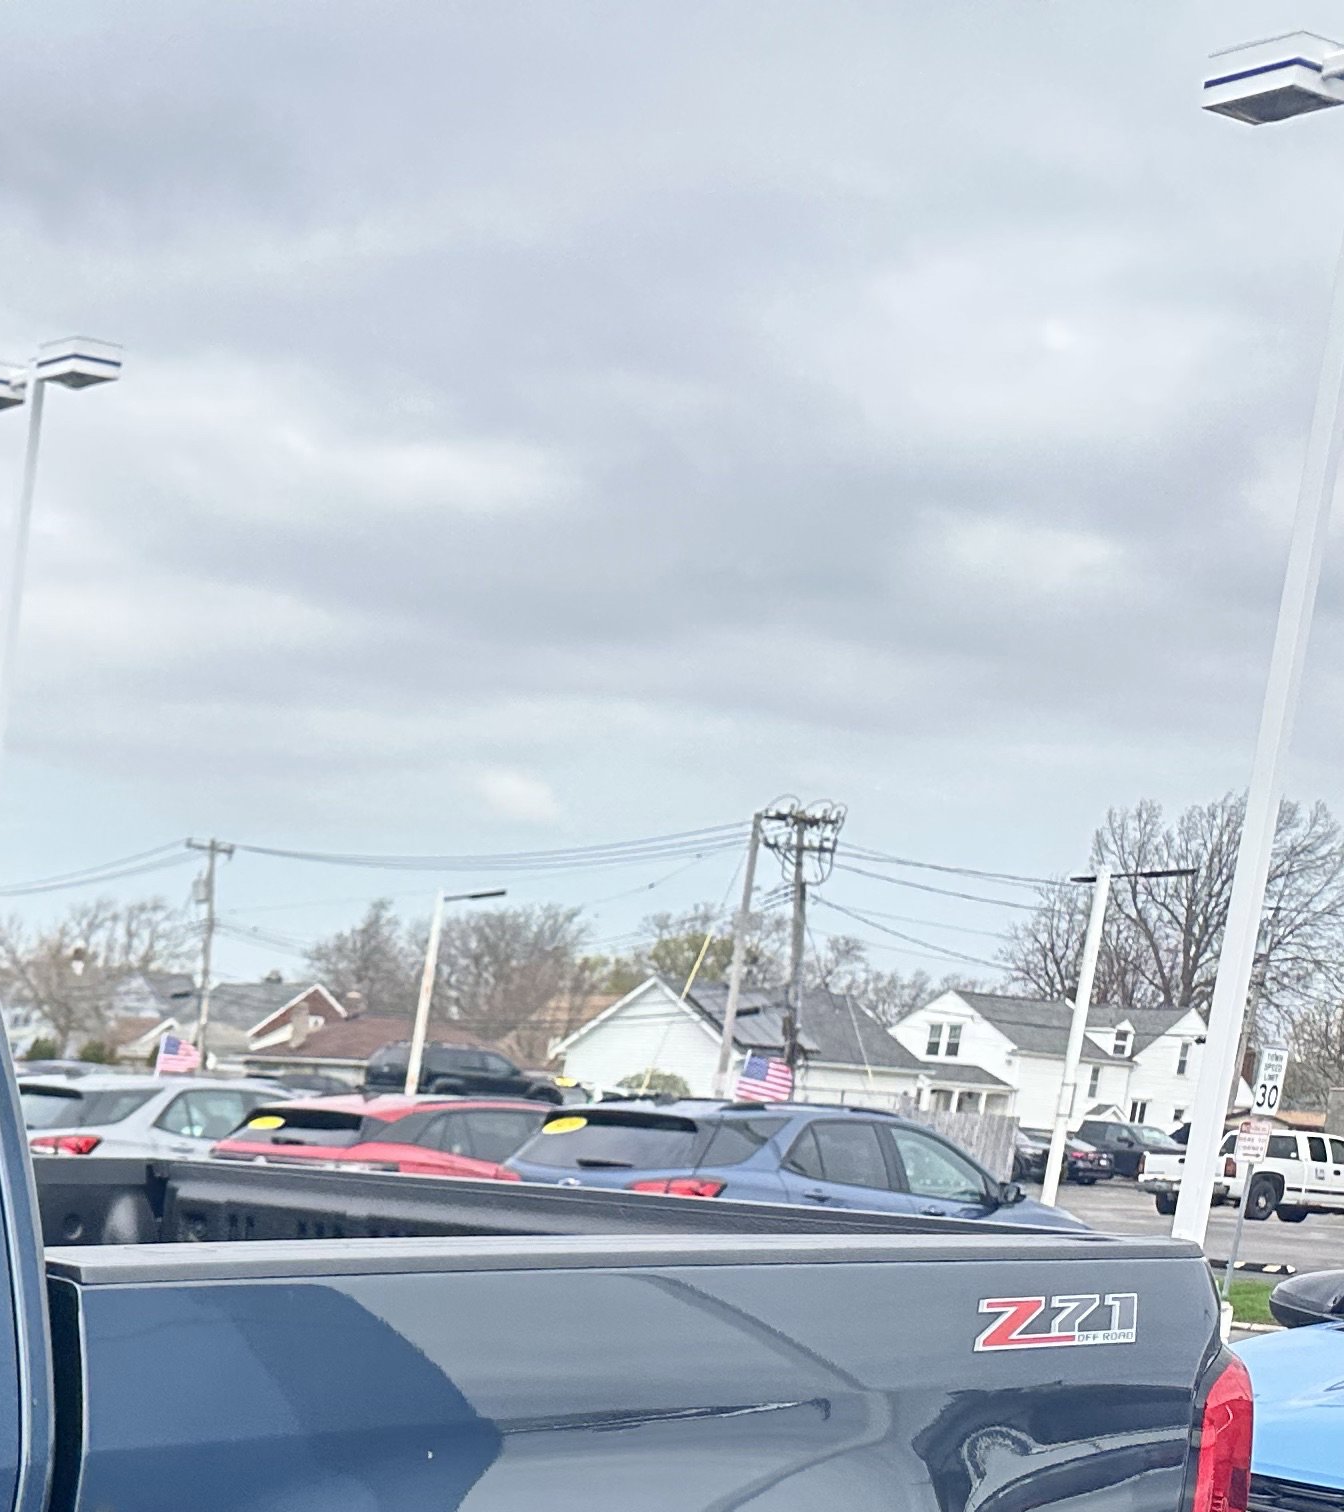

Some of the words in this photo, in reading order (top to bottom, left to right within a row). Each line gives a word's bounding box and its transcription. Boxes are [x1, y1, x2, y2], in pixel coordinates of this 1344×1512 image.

[1264, 1063, 1282, 1073] SPEED
[1256, 1084, 1278, 1109] 30
[973, 1293, 1138, 1352] Z71
[1078, 1334, 1099, 1342] OFF
[1103, 1331, 1134, 1341] ROAD
